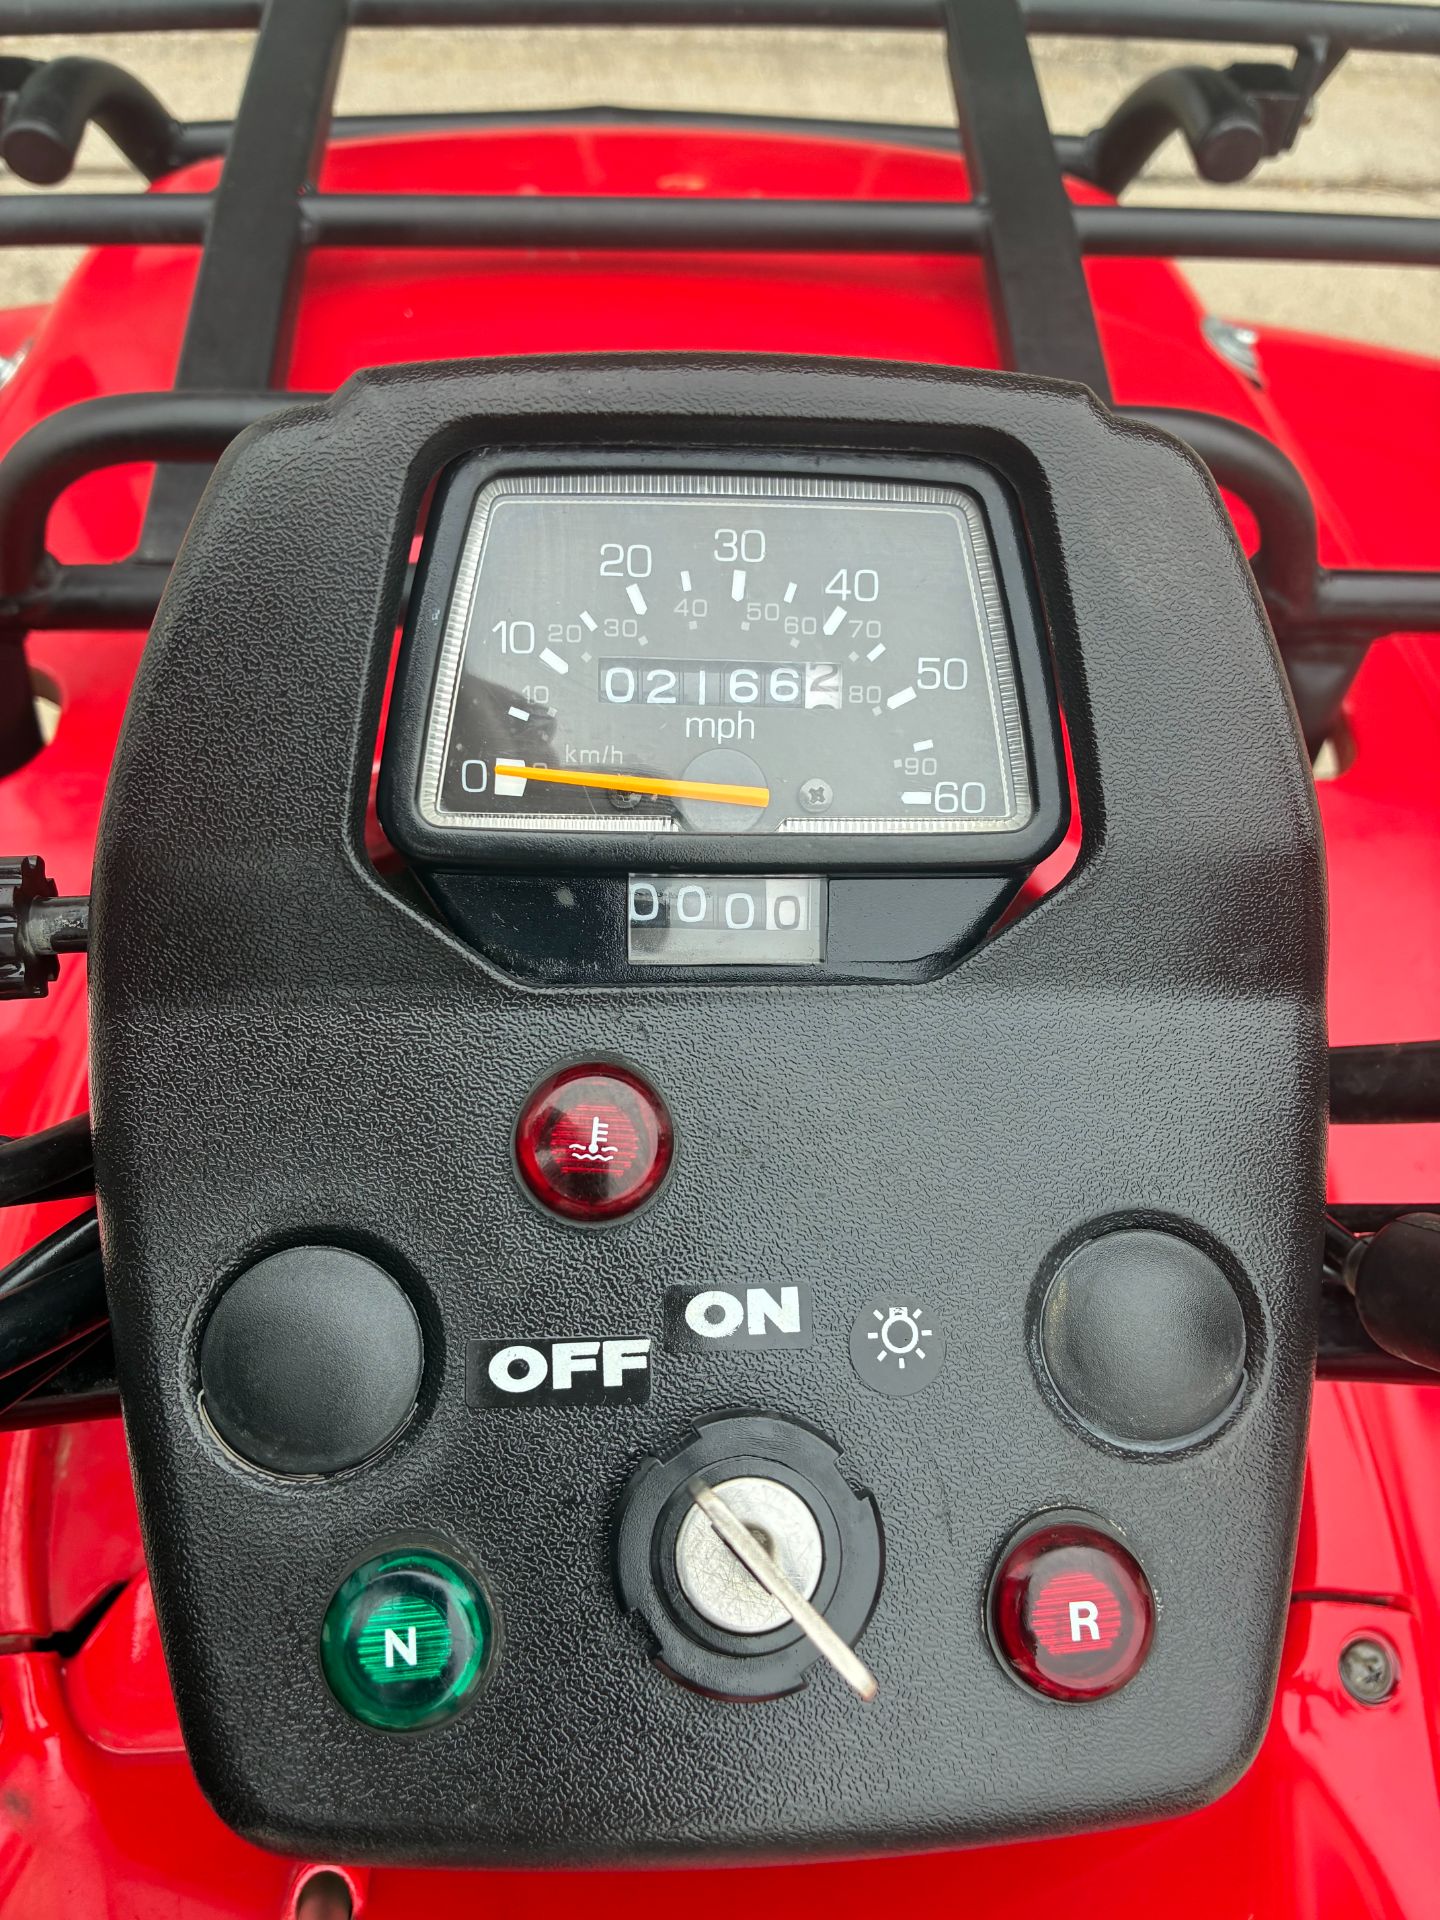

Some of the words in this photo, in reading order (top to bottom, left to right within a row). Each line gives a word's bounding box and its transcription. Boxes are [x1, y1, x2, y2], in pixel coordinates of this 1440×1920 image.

[600, 543, 652, 578] 20
[713, 528, 766, 563] 30
[825, 569, 879, 602] 40
[673, 599, 708, 617] 40
[746, 603, 780, 621] 50
[492, 620, 535, 654] 10
[548, 624, 582, 643] 20
[603, 619, 638, 637] 30
[784, 617, 817, 635] 60
[849, 620, 882, 638] 70
[917, 657, 968, 690] 50
[522, 685, 549, 704] 10
[849, 686, 882, 704] 80
[685, 710, 755, 744] mph
[565, 744, 624, 765] km/h
[904, 757, 937, 775] 90
[461, 759, 488, 793] 0
[935, 781, 986, 813] 60
[630, 882, 801, 930] 0000
[685, 1286, 801, 1338] ON
[488, 1339, 651, 1393] OFF
[1069, 1601, 1100, 1642] R
[385, 1626, 417, 1668] N
